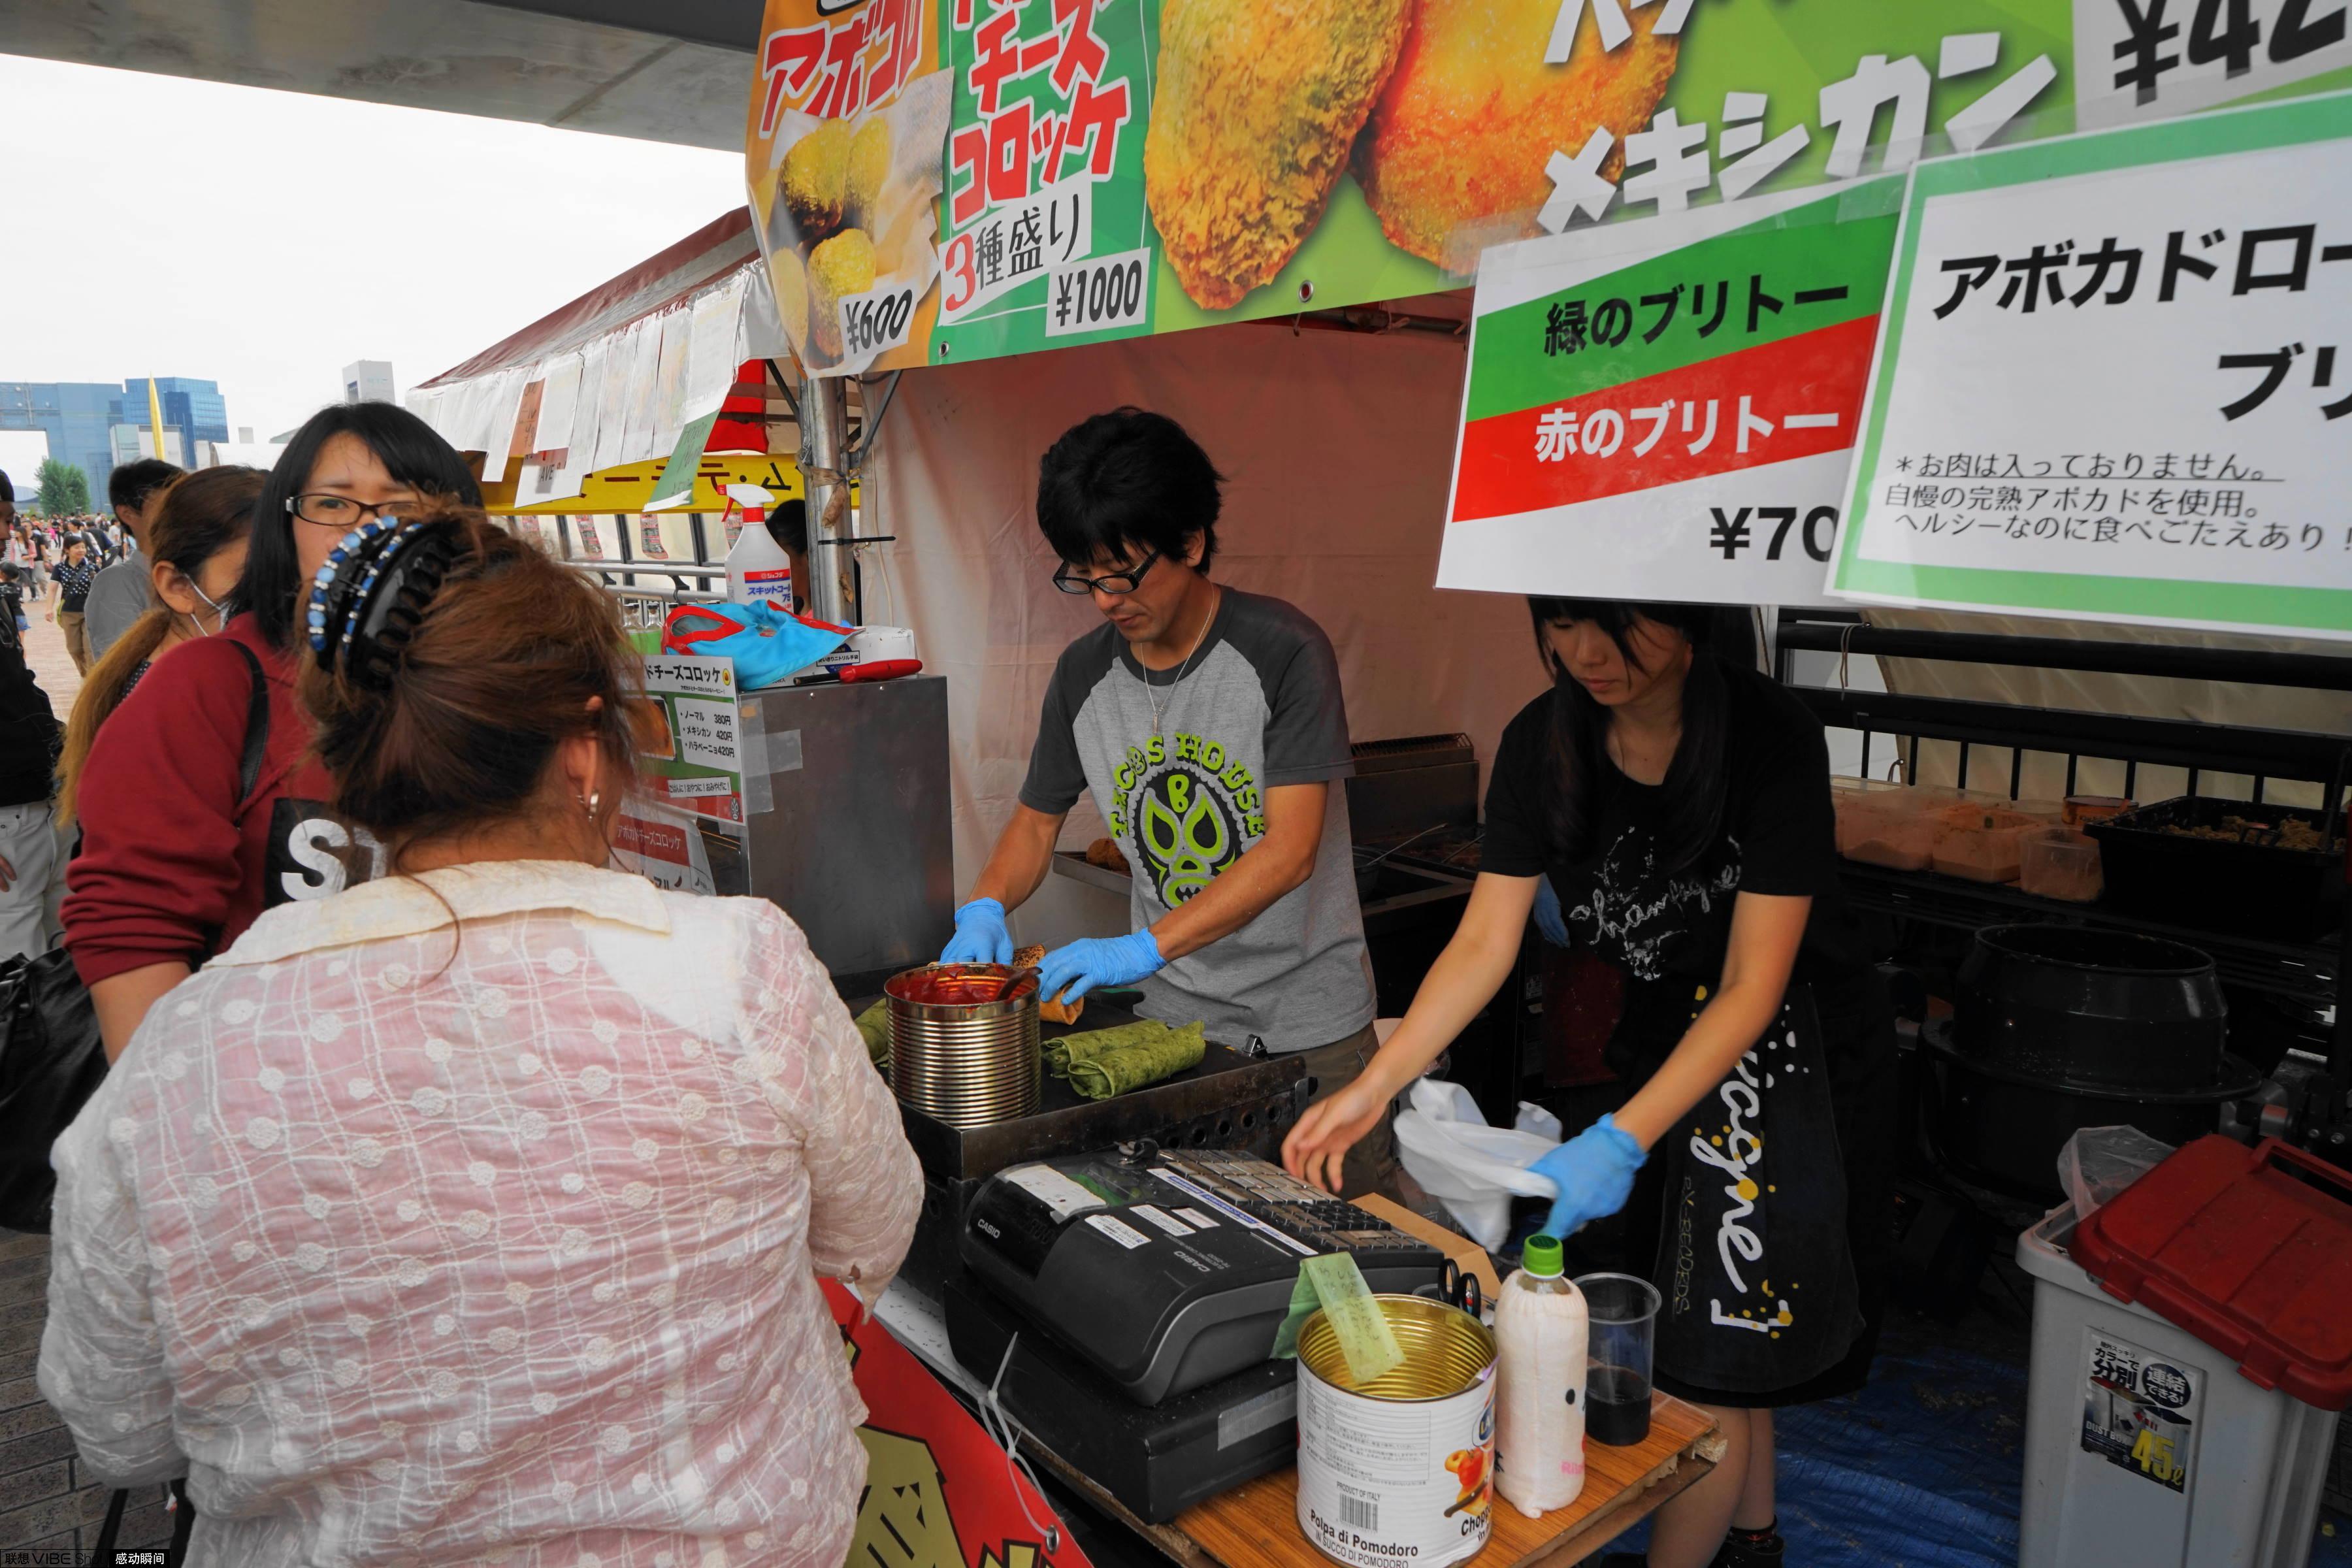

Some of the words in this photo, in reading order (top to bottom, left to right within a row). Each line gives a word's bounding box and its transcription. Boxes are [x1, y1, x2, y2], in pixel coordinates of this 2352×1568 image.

[1536, 31, 2058, 235] メキシカン
[952, 80, 1128, 225] コロッケ
[945, 193, 1080, 313] 3種盛り
[1055, 259, 1142, 327] ¥1000
[845, 288, 913, 354] ¥600
[1543, 274, 1849, 357] 緑のブリトー
[1534, 395, 1839, 463] 赤のブリトー
[1885, 482, 2259, 520] 自慢の完熟アボカドを使用。
[713, 713, 731, 726] 380円
[716, 730, 733, 742] 420円
[718, 745, 735, 758] 420円
[1175, 731, 1266, 839] HOUSE
[617, 825, 681, 851] アボカドチーズコロッケ
[977, 1218, 1002, 1239] CASIO
[1173, 1250, 1211, 1273] CASIO
[2092, 1358, 2138, 1391] 分別
[2095, 1347, 2140, 1371] カラーで
[2148, 1367, 2186, 1395] 連結
[2085, 1420, 2110, 1437] DUST
[1336, 1480, 1359, 1496] PRODUCT
[1359, 1489, 1366, 1498] OF
[1366, 1490, 1381, 1501] ITALY
[1311, 1508, 1335, 1537] Polpa
[1338, 1529, 1348, 1544] di
[1352, 1534, 1419, 1557] Pomodoro
[1315, 1530, 1322, 1543] IN
[1322, 1535, 1347, 1558] SUCCO
[1348, 1549, 1356, 1561] DI
[1358, 1553, 1409, 1568] POMODORO
